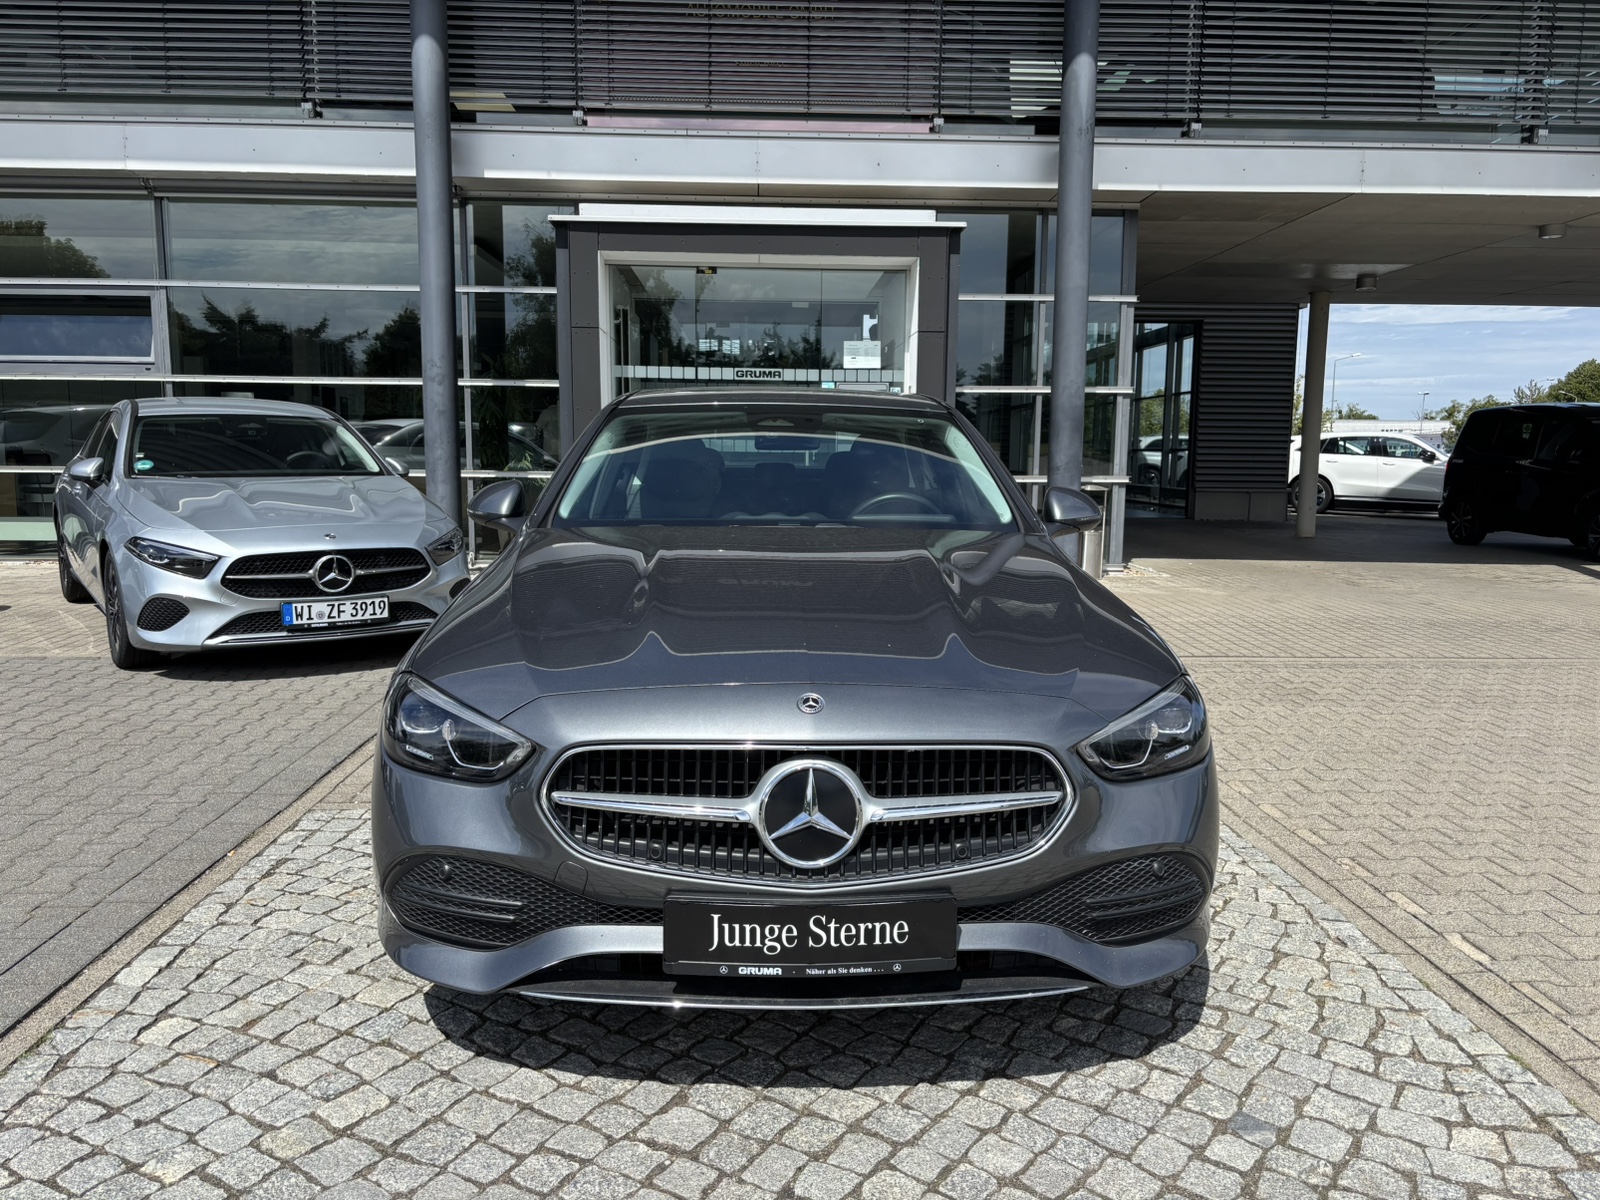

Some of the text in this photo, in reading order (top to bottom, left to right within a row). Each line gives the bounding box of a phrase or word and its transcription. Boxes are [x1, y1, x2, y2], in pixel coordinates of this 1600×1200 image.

[735, 369, 782, 380] GRUMA
[294, 600, 387, 622] WI ZF 3919
[708, 913, 909, 955] Junge Sterne
[738, 966, 783, 976] GRUMA
